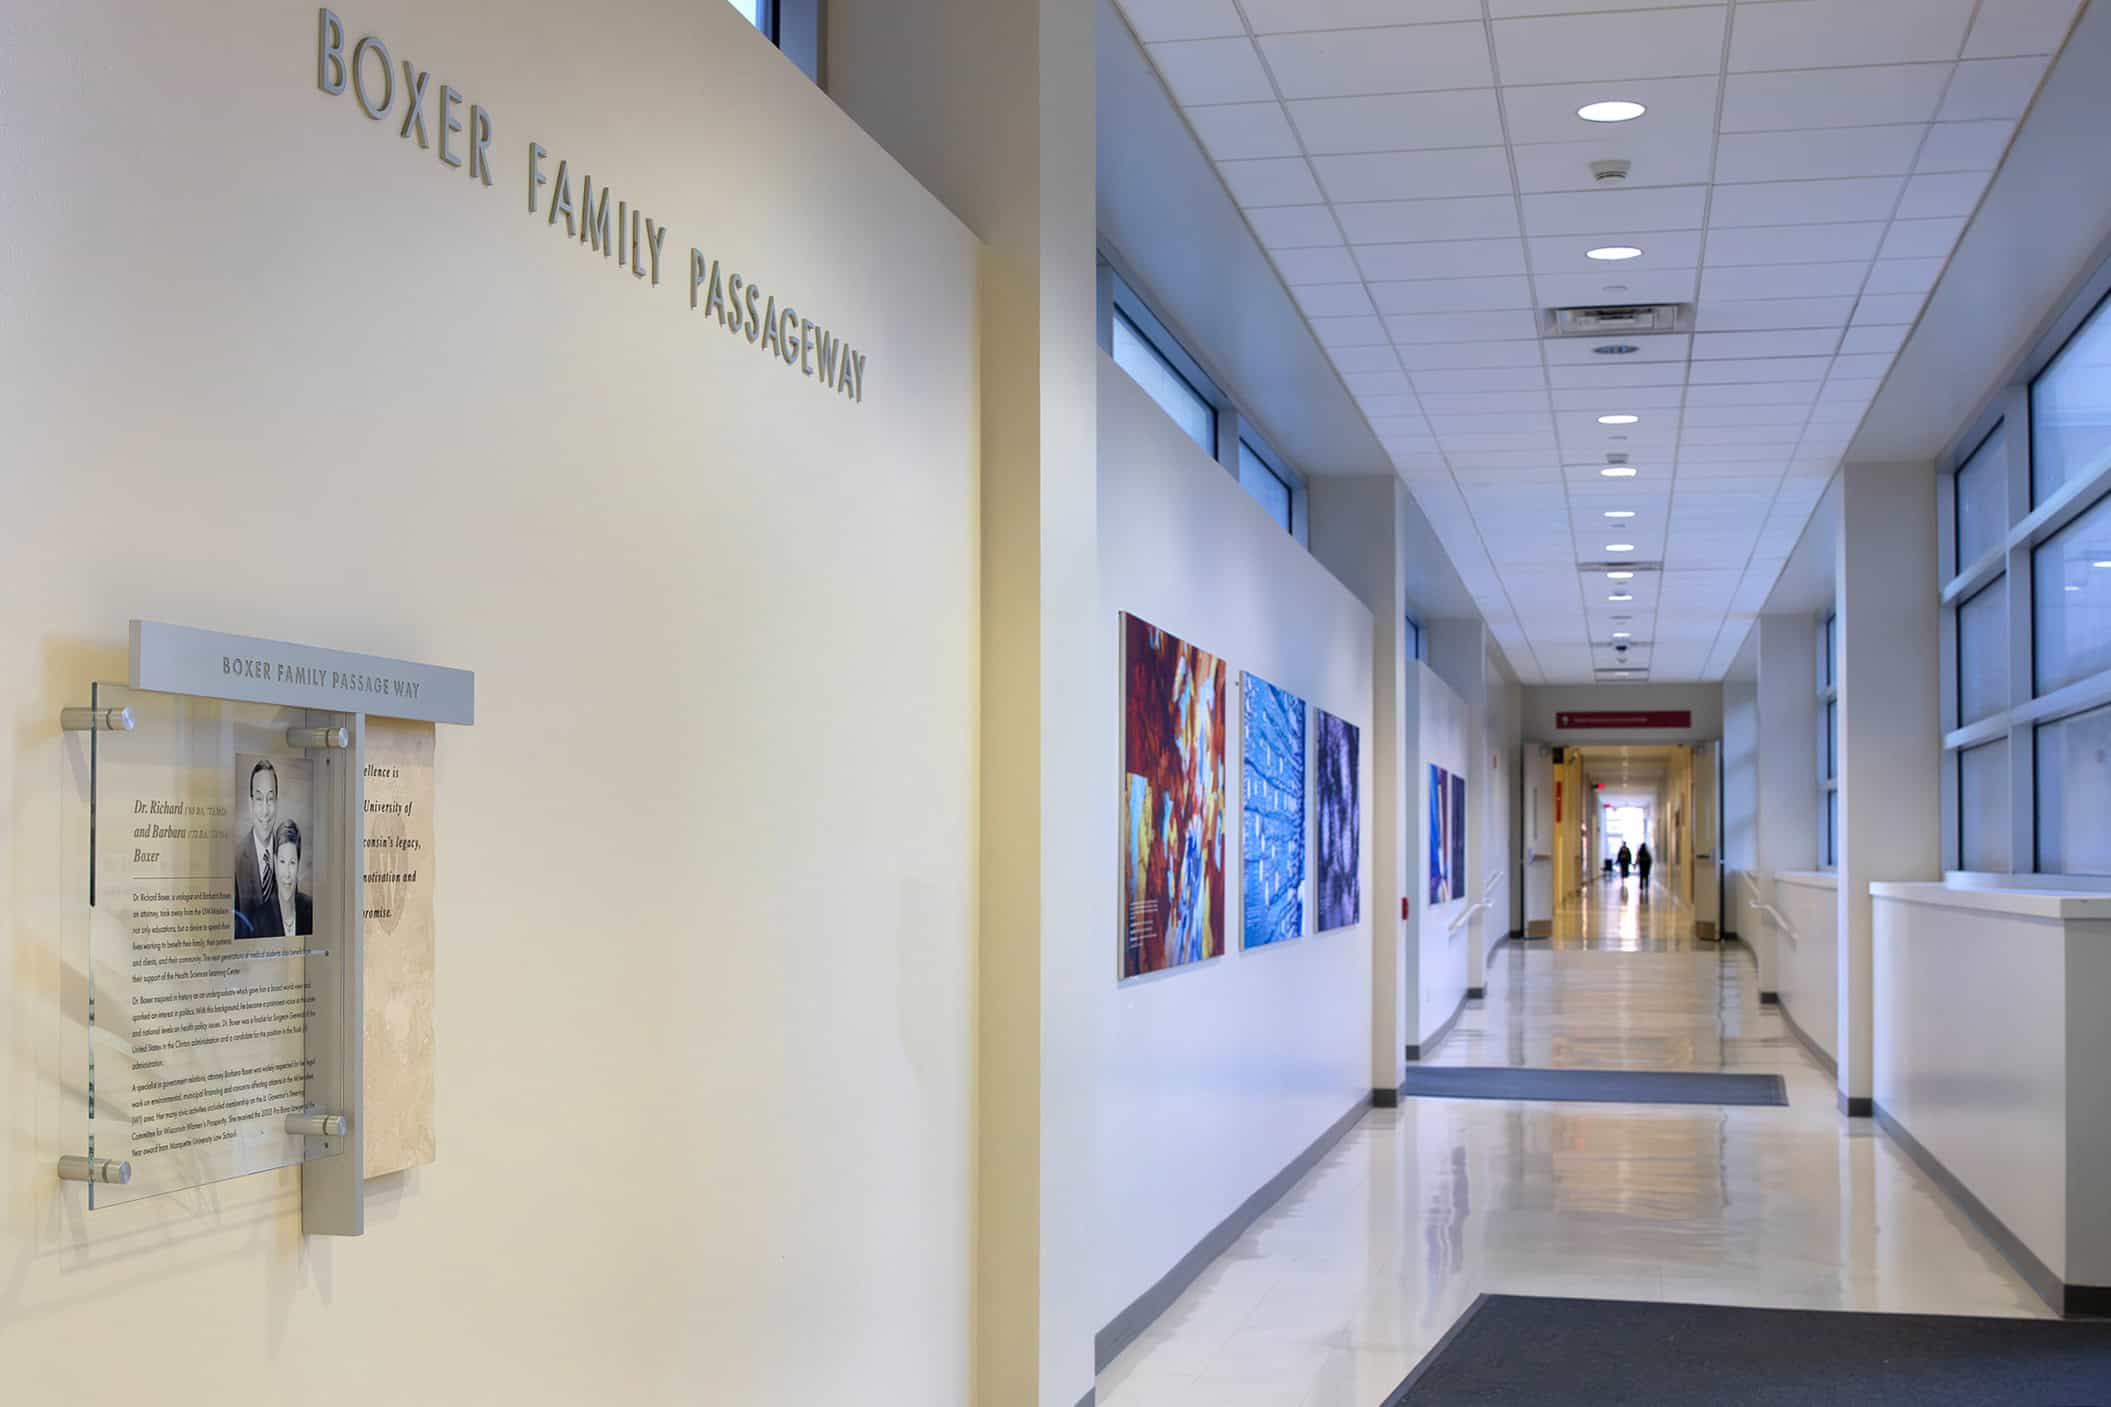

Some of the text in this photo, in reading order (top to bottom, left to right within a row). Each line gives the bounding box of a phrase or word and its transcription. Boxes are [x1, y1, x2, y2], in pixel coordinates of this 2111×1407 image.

[318, 8, 866, 402] BOXER FAMILY PASSAGEWAY
[222, 656, 420, 699] BOXER FAMILY PASSAGE WAY
[392, 766, 399, 778] is
[134, 800, 148, 814] Dr.
[150, 800, 184, 815] Richard
[363, 799, 413, 816] University of
[133, 824, 151, 838] and
[152, 824, 186, 839] Barbara
[395, 836, 421, 851] legacy,
[133, 848, 160, 863] Boxer
[402, 870, 417, 882] and
